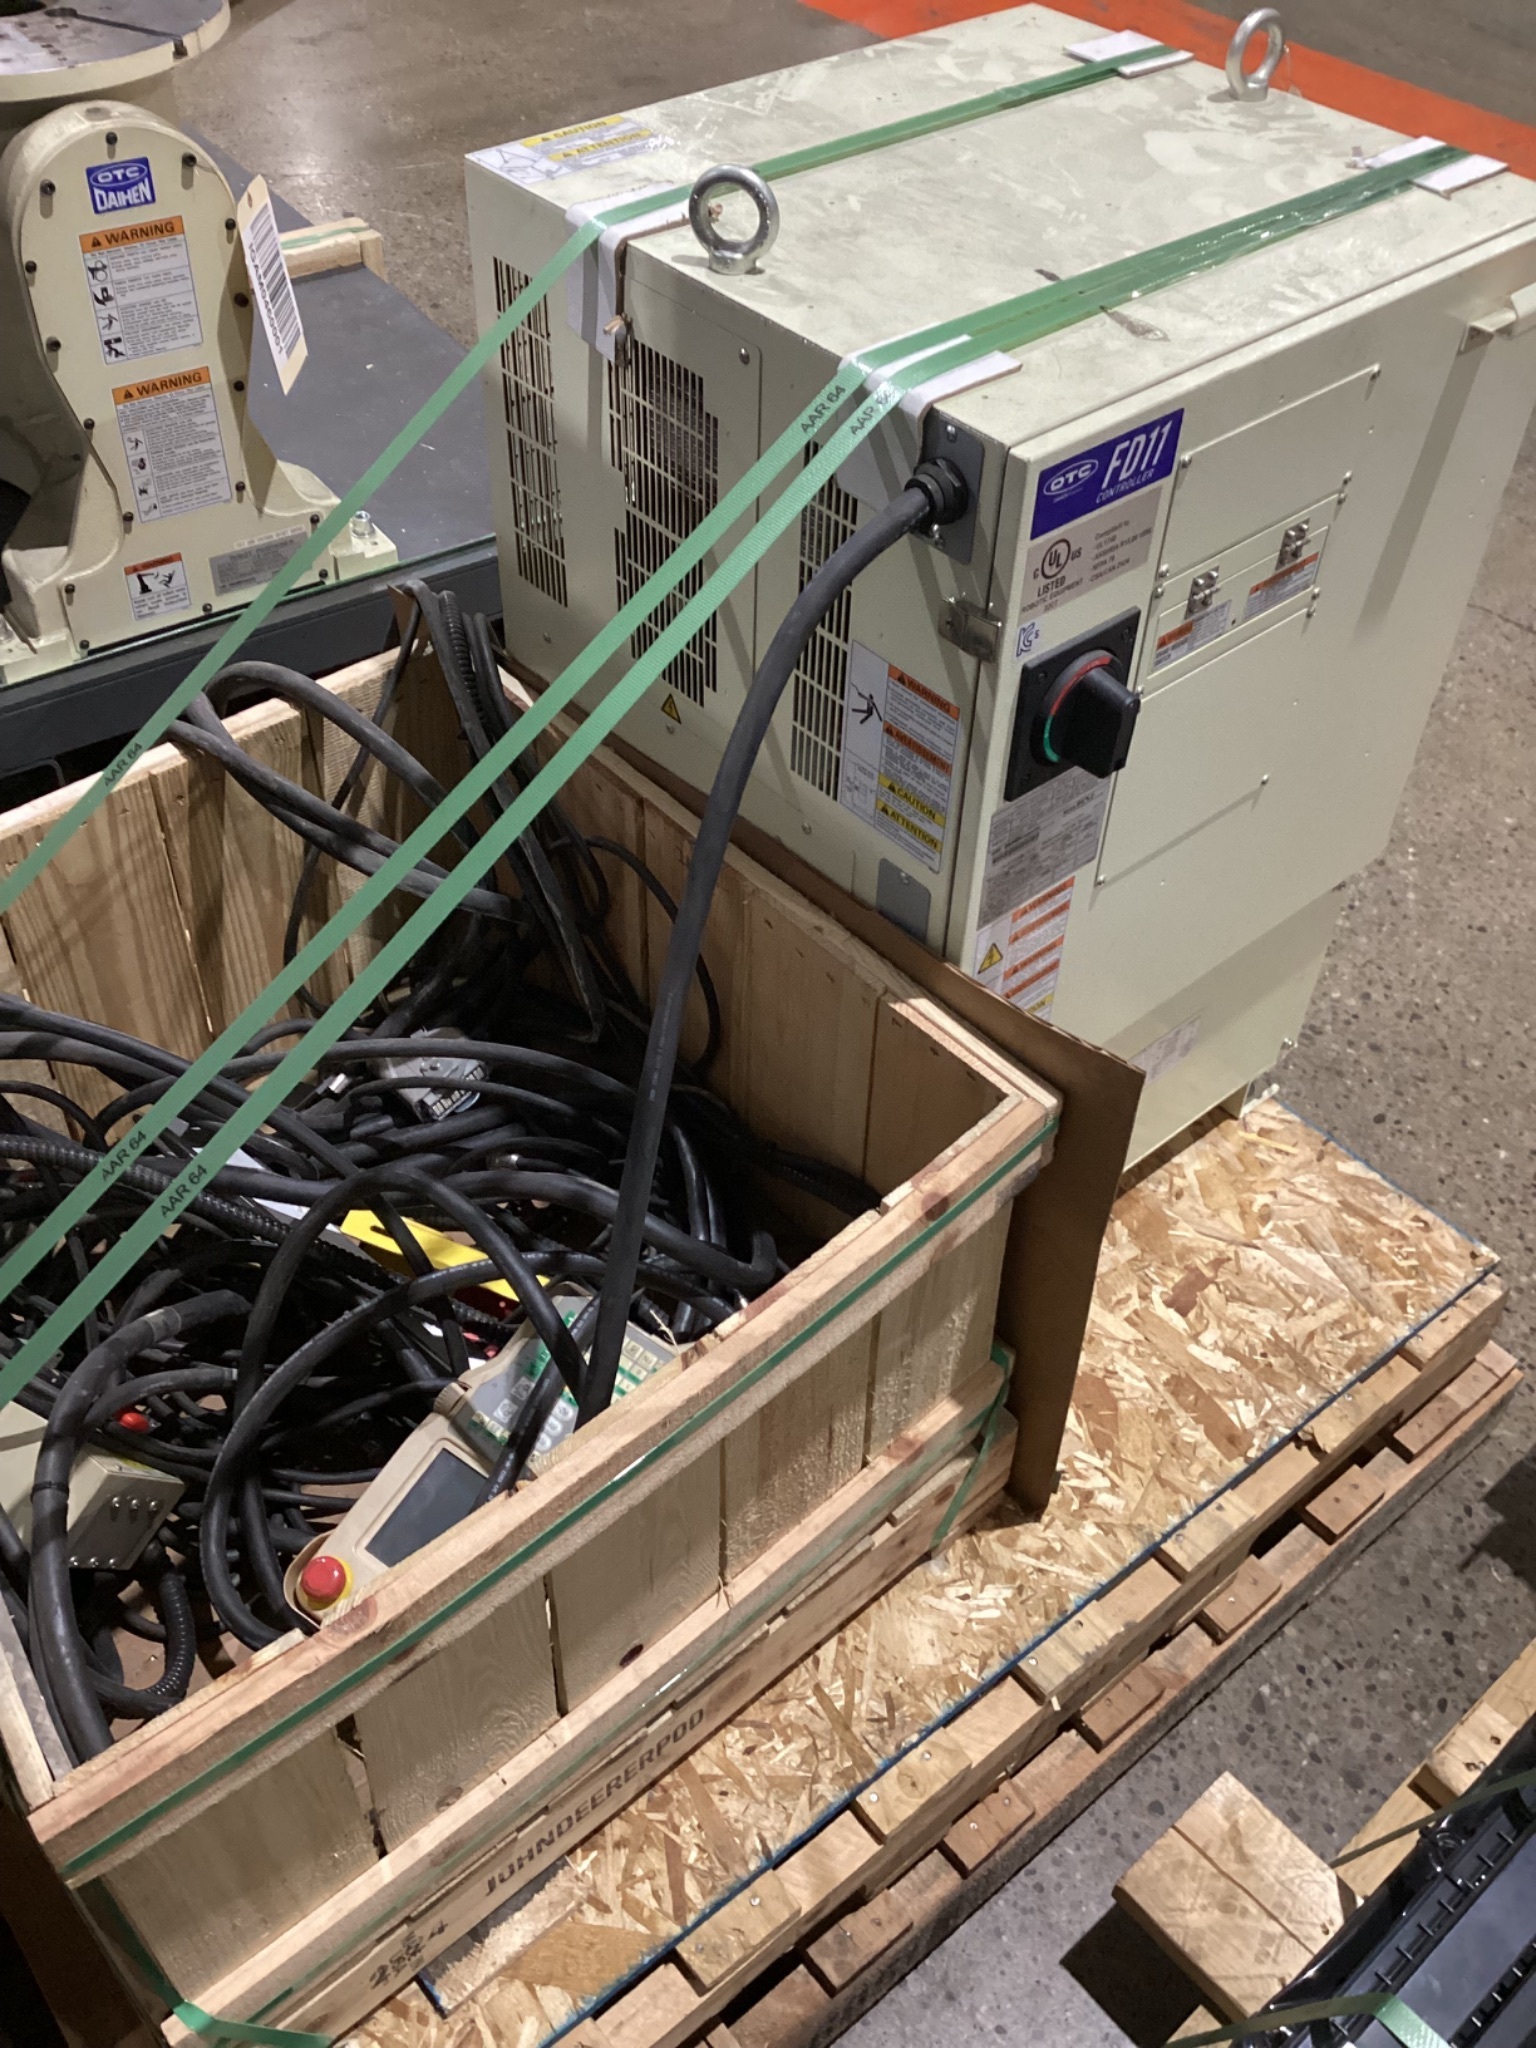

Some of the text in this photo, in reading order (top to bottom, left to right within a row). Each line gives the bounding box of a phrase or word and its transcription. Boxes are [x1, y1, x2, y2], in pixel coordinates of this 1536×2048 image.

[96, 165, 141, 184] OTC
[93, 176, 153, 212] DAIHEN
[105, 221, 175, 246] WARNING
[136, 372, 202, 397] WARNING
[800, 384, 847, 434] AAR 64
[1050, 420, 1173, 492] OTC FD11
[1096, 468, 1156, 504] CONTROLLER
[1048, 549, 1063, 569] UL
[1070, 546, 1083, 562] US
[1037, 575, 1067, 598] LISTED
[906, 674, 951, 715] WARNING
[104, 742, 143, 788] AAR 64
[896, 784, 937, 821] CAUTION
[889, 804, 938, 849] ATTENTION
[101, 1129, 147, 1181] AAR 64
[160, 1164, 208, 1218] AAR 64
